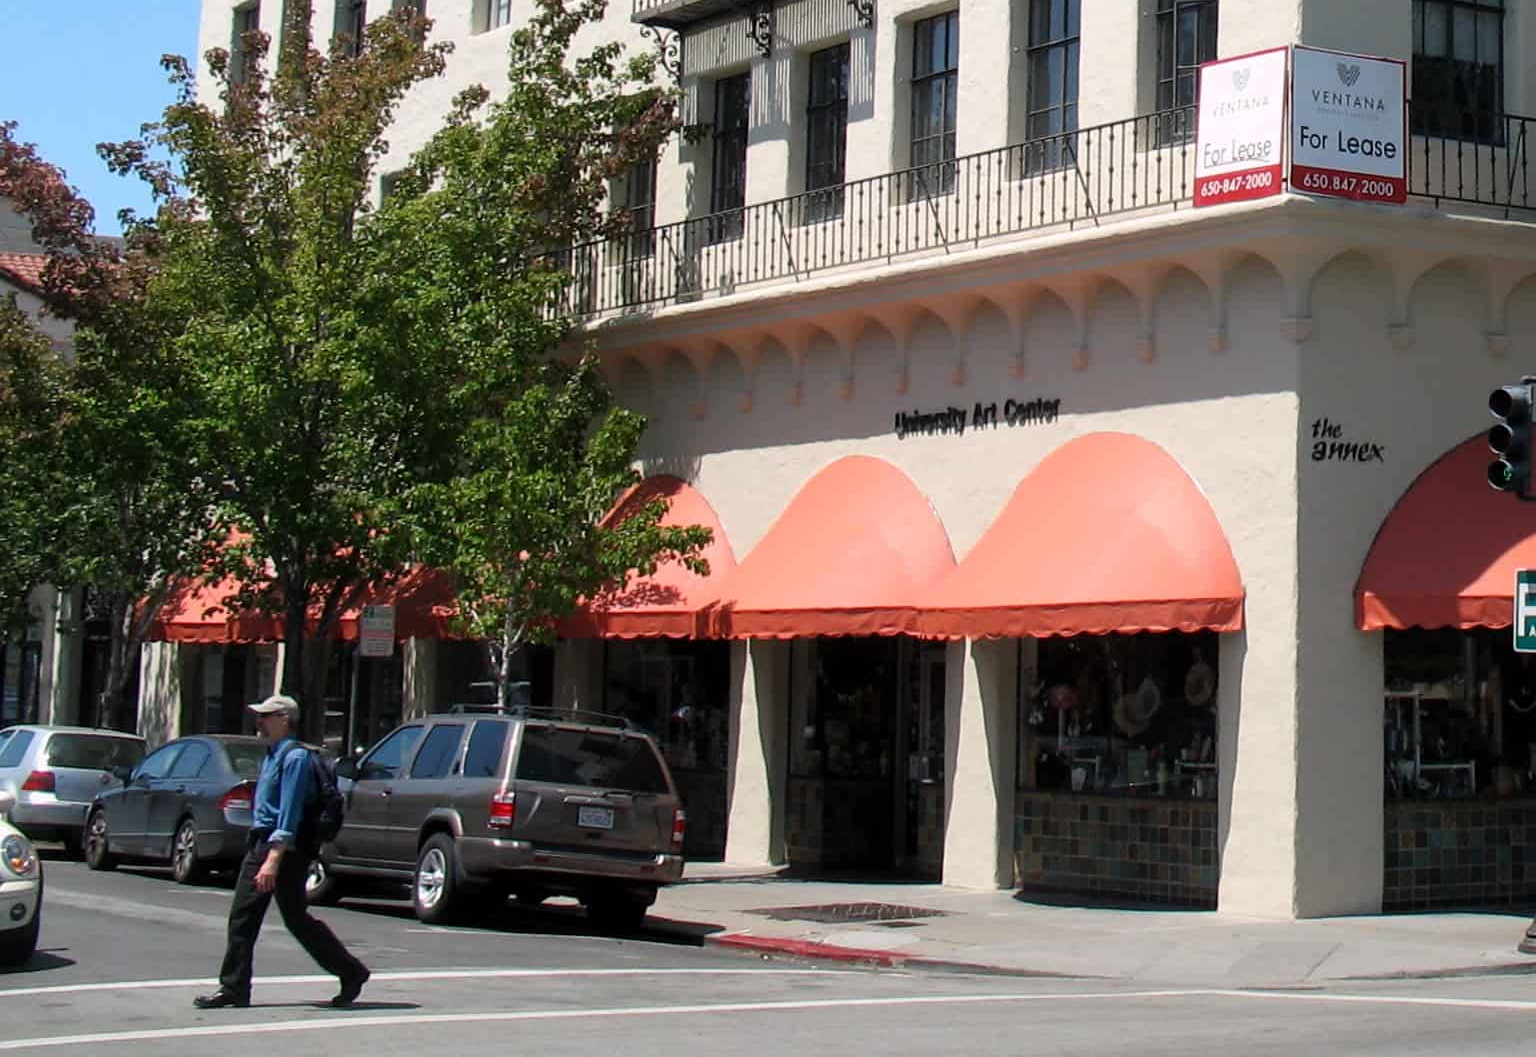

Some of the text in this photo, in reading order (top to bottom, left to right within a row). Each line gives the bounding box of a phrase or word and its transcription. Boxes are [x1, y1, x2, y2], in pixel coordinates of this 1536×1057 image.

[1312, 89, 1385, 111] VENTANA
[1203, 138, 1272, 167] For Lease
[1300, 126, 1396, 159] For Lease
[1200, 171, 1272, 197] 650-847-2000
[1303, 173, 1394, 197] 650.847.2000
[895, 398, 1061, 440] University Art Center
[1311, 417, 1343, 439] the
[1311, 441, 1385, 463] annex
